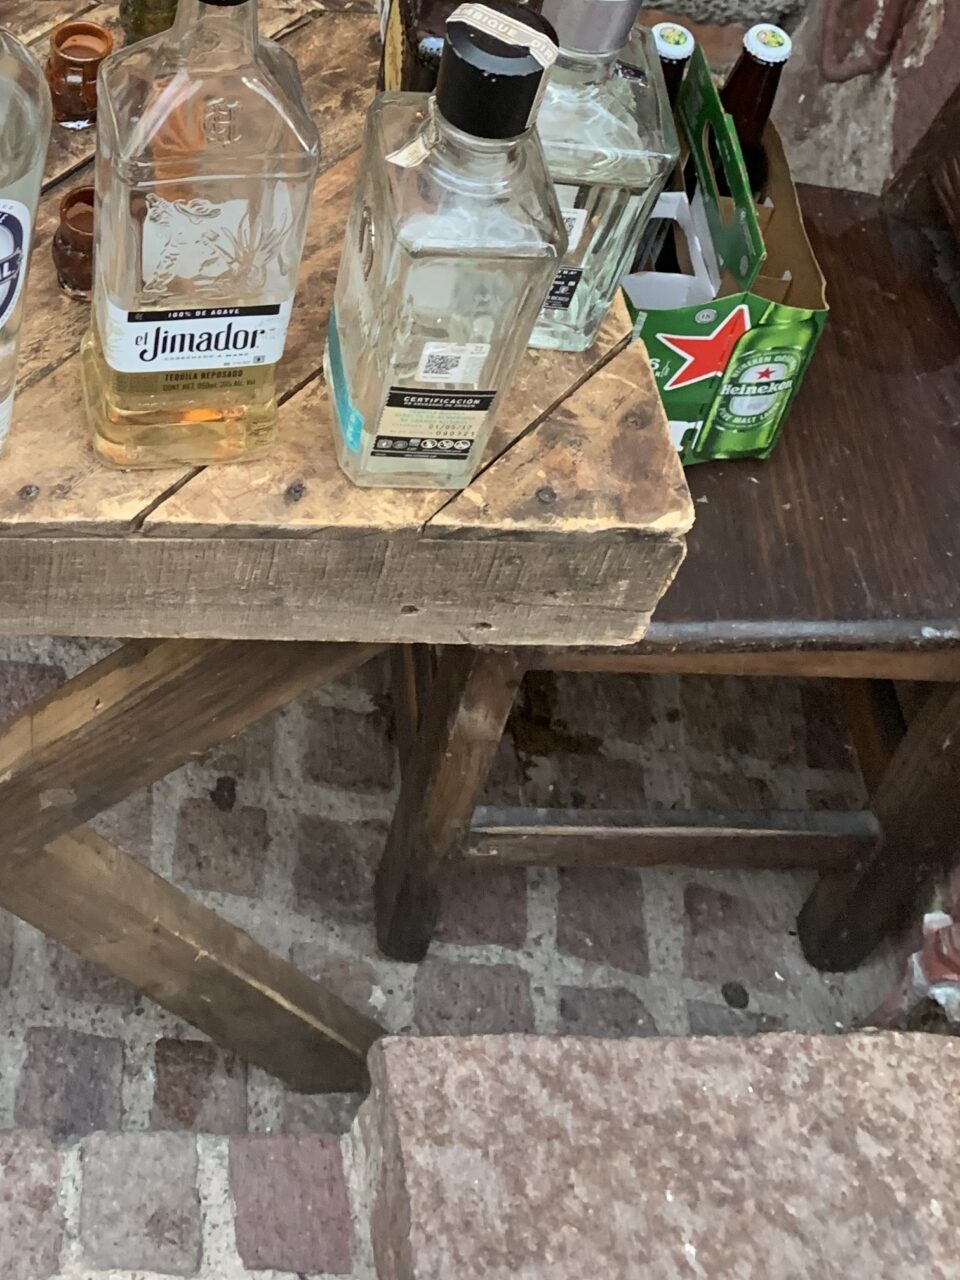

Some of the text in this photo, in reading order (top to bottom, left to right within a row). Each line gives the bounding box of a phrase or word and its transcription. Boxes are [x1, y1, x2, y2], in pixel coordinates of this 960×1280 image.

[194, 309, 207, 317] DE
[210, 308, 241, 316] AGAVE
[135, 322, 266, 362] el Jimador
[164, 369, 244, 382] TEQUILA REPOSADO
[720, 379, 793, 396] Heineken
[403, 395, 481, 405] CERTIFICACIÓN
[734, 416, 757, 424] MALT
